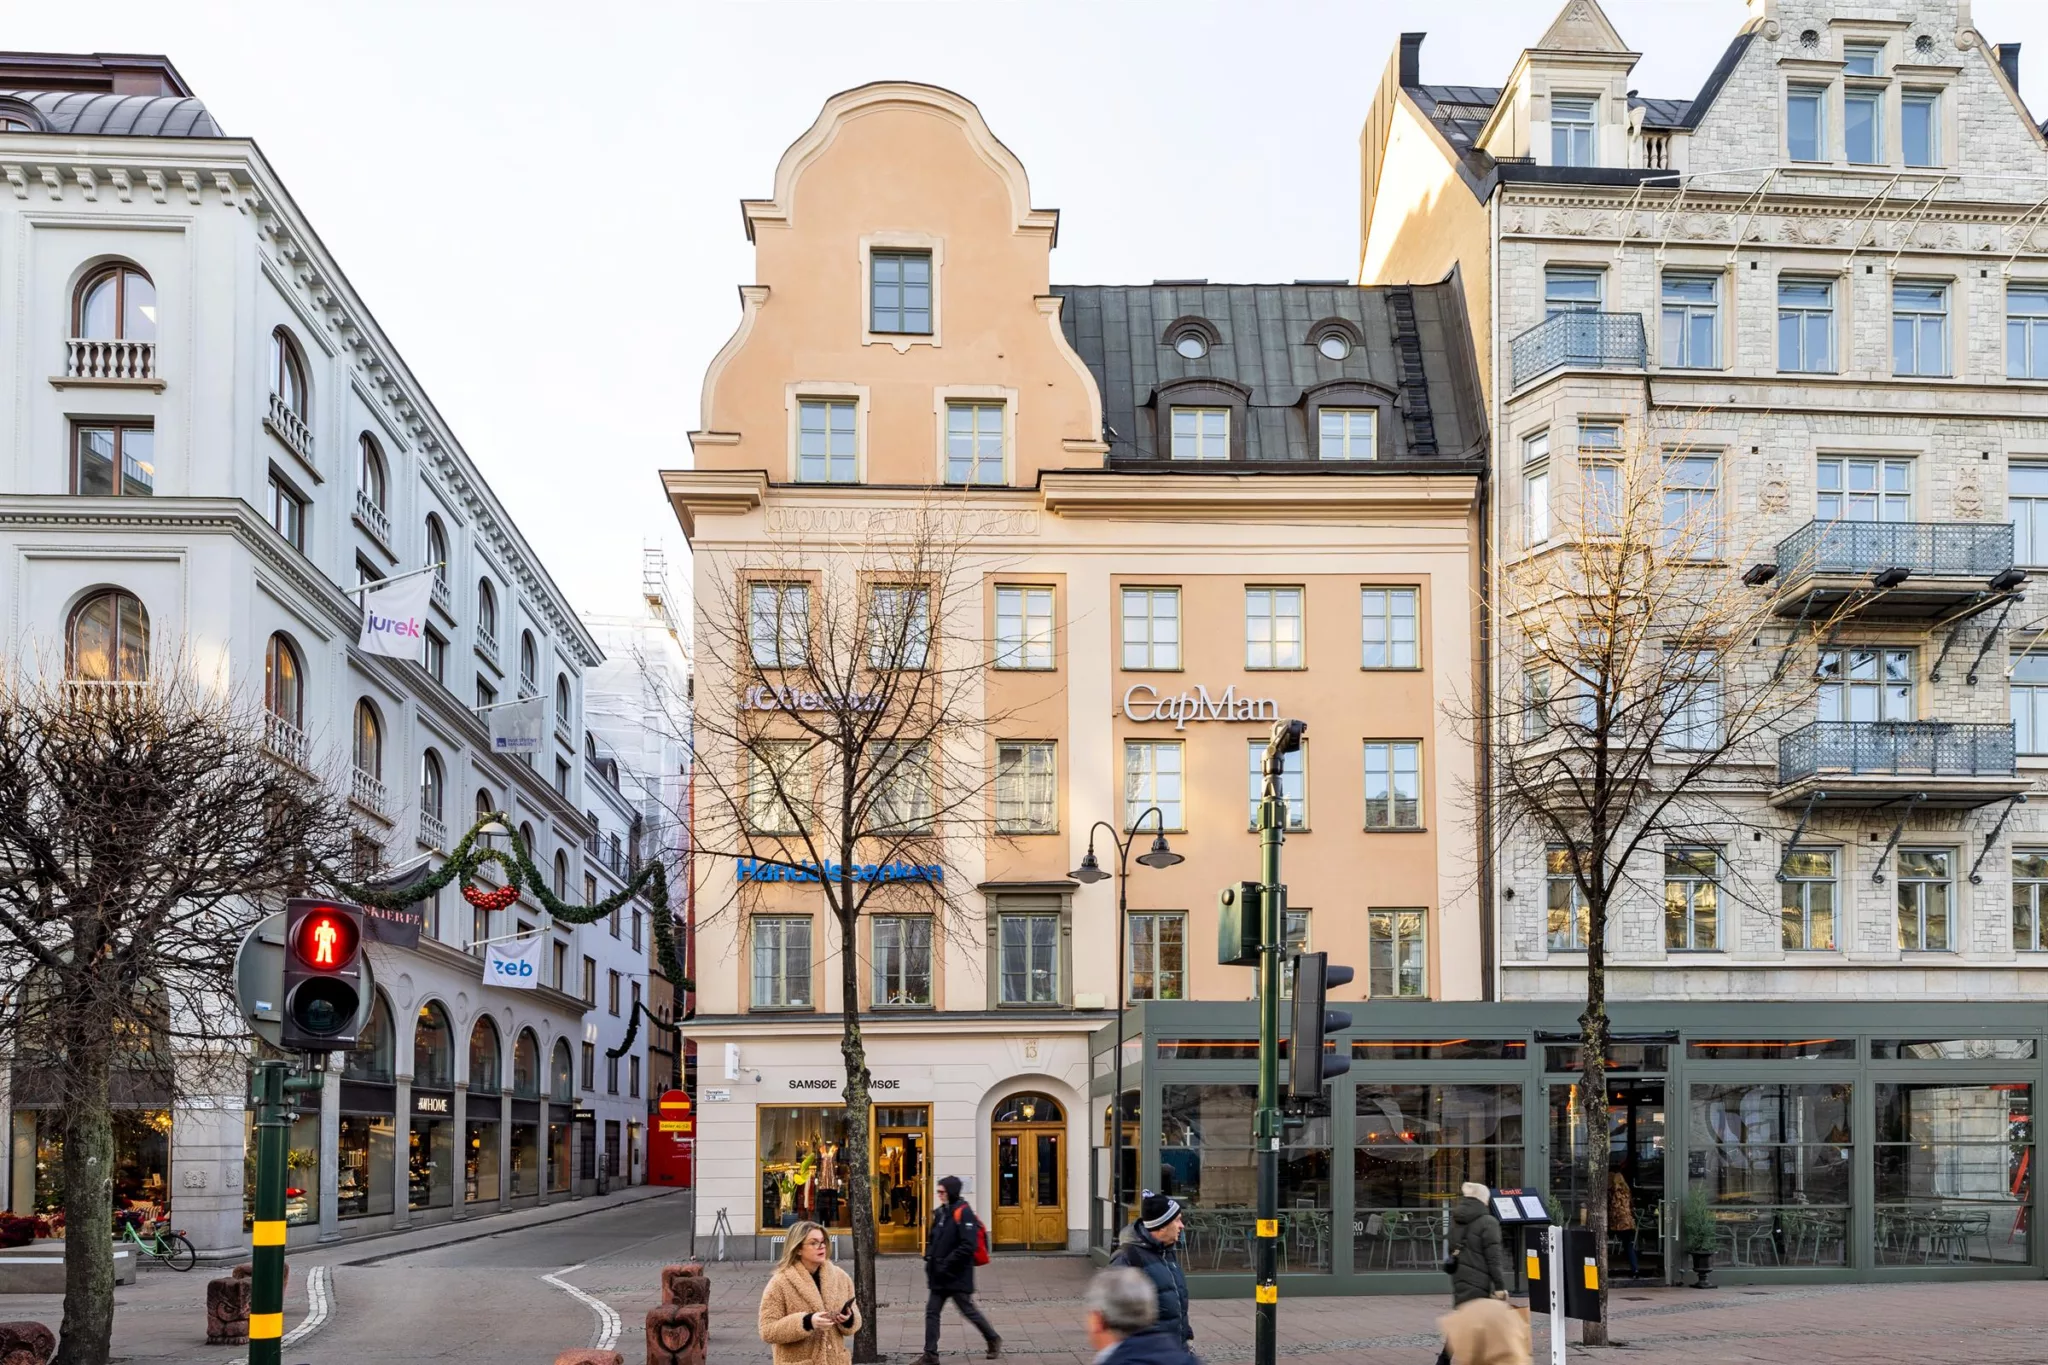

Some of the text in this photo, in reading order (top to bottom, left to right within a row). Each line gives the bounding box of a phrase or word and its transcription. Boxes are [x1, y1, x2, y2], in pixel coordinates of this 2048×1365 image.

[367, 610, 419, 638] jurek
[1123, 684, 1280, 731] CapMan
[493, 959, 533, 977] zeb
[788, 1079, 900, 1089] SAMSØE MSØE
